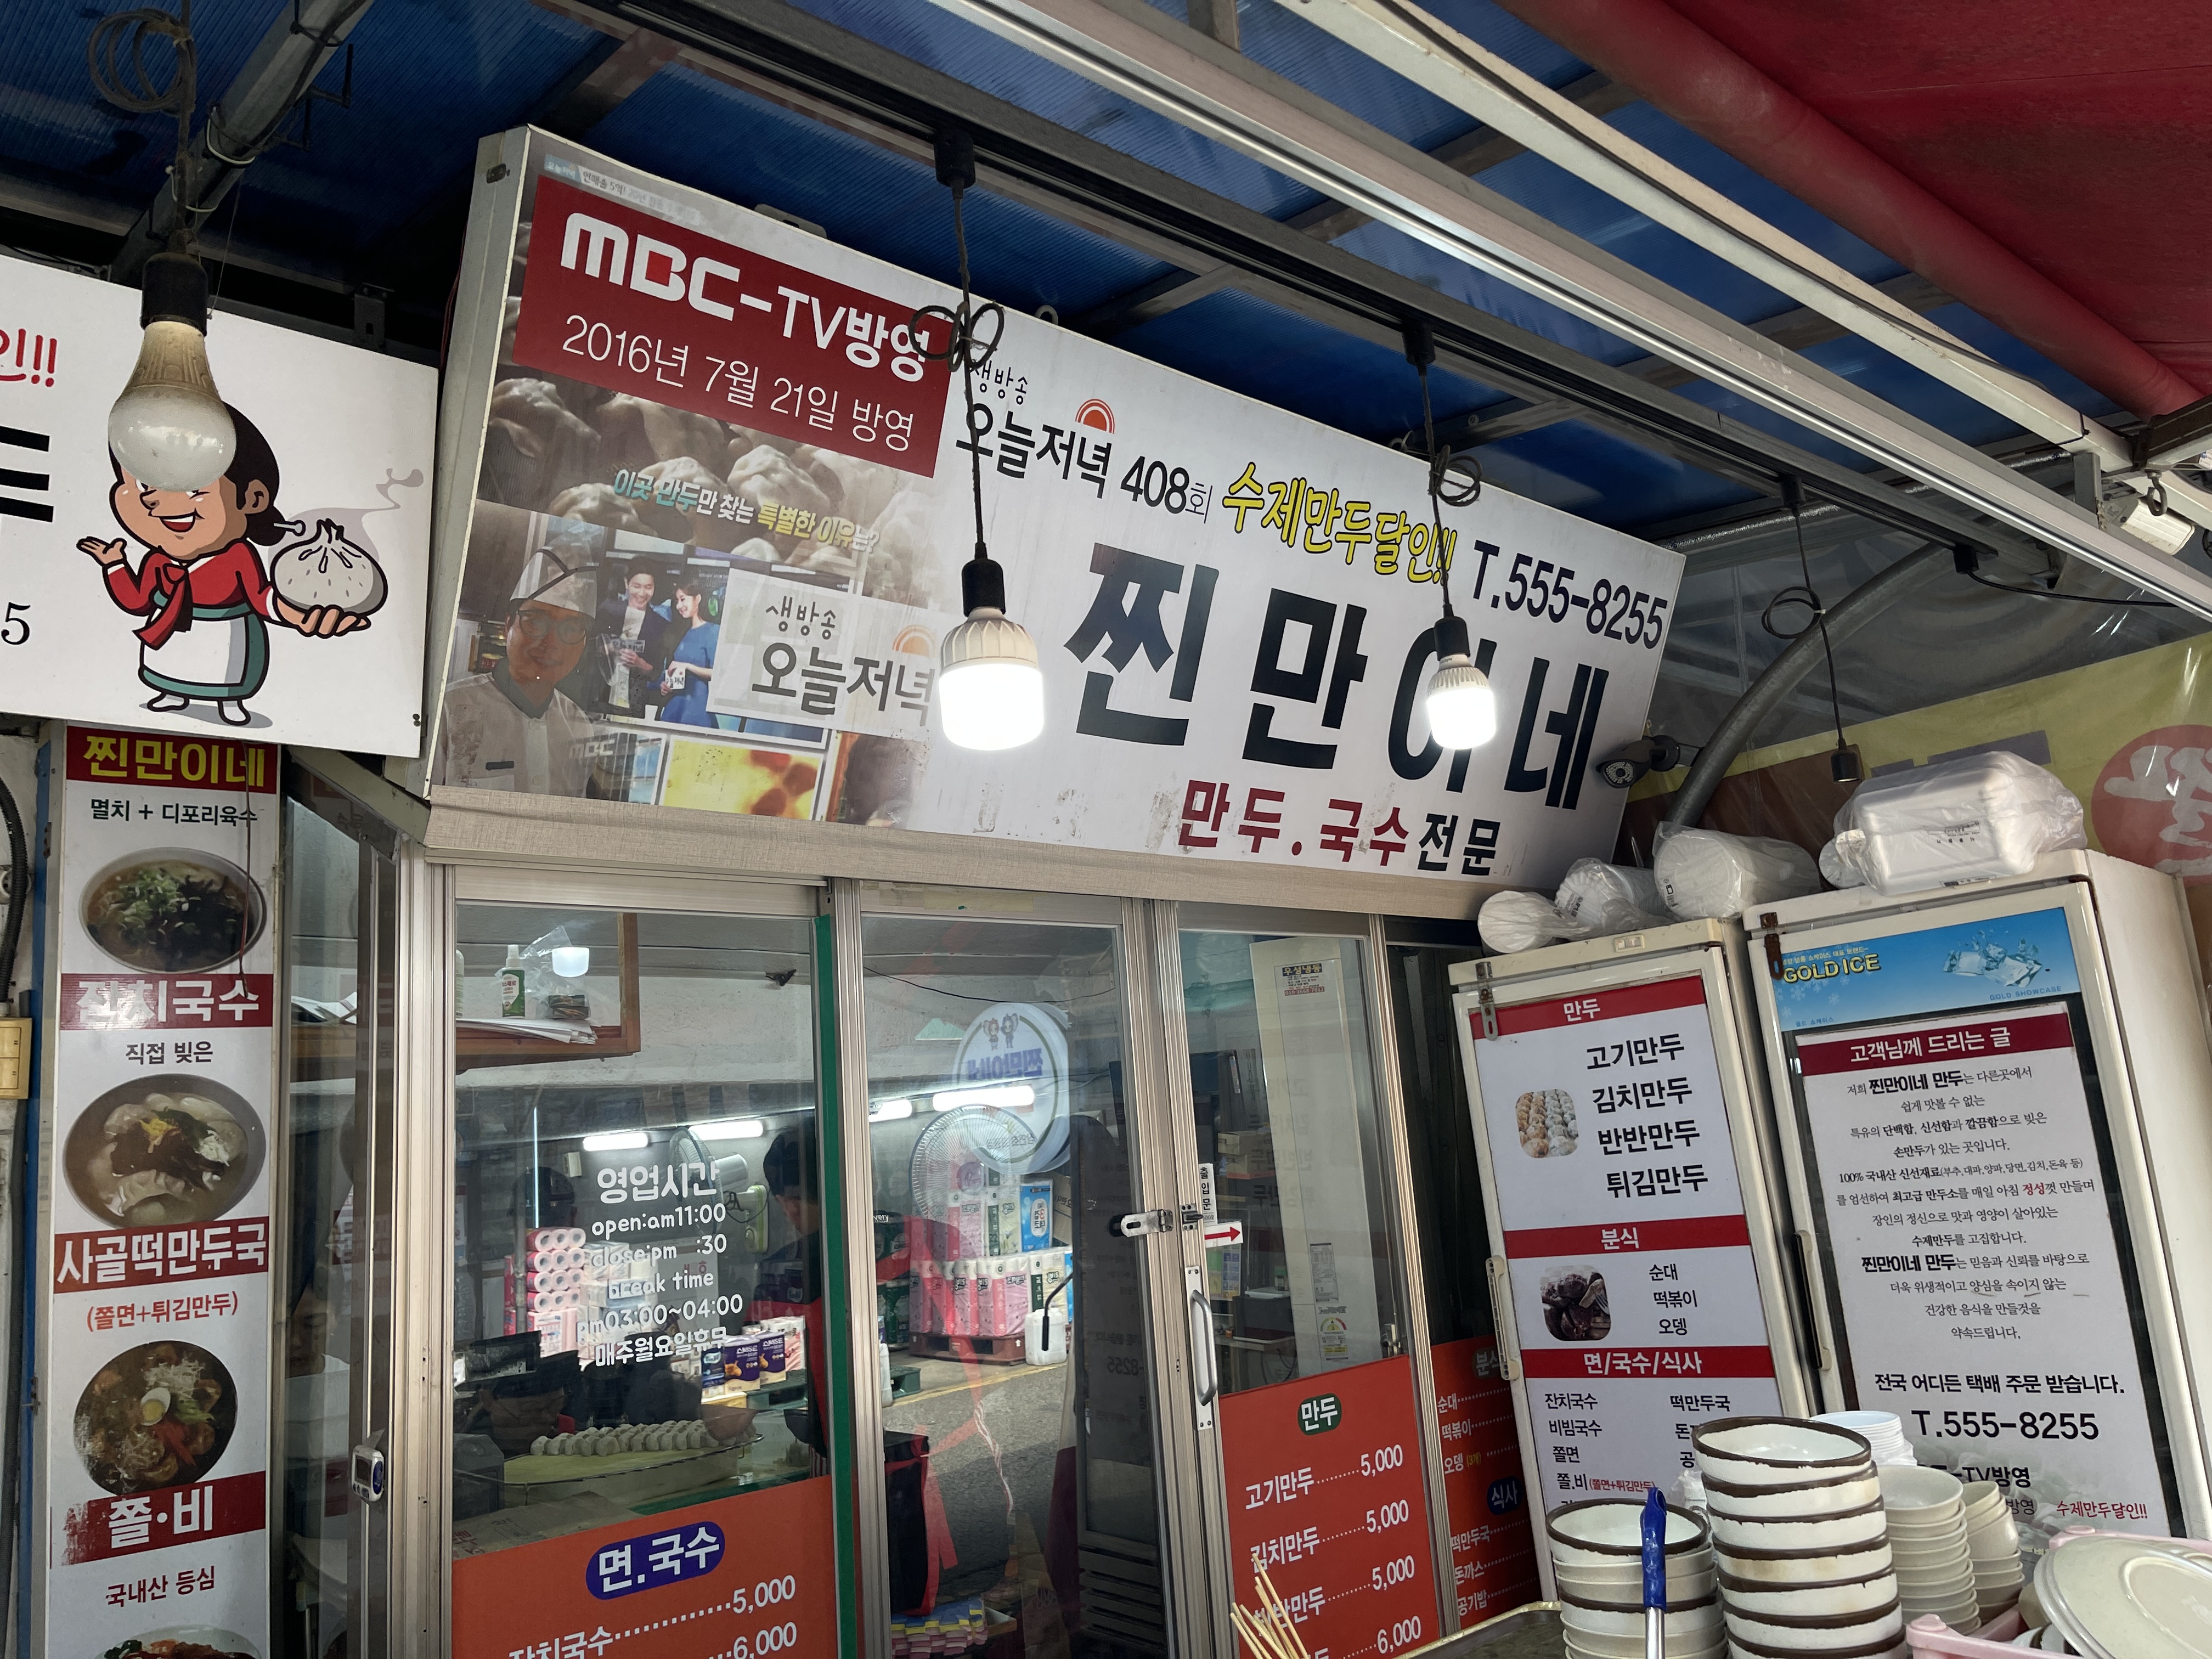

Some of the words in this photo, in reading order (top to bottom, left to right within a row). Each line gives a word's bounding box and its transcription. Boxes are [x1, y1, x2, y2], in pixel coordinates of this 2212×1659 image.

[562, 315, 689, 388] 2016년
[706, 357, 759, 409] 7월
[770, 377, 838, 432] 21일
[852, 399, 913, 453] 방영
[613, 468, 654, 500] 이곳
[655, 477, 718, 516] 만두만
[719, 494, 754, 525] 찾는
[757, 502, 816, 541] 특별한
[956, 403, 1113, 499] 오늘저녁
[1120, 456, 1212, 524] 408회
[1222, 462, 1457, 585] 수제만두달인!!
[1473, 539, 1668, 650] T.555-8255
[766, 595, 838, 641] 생방송
[752, 641, 936, 727] 오늘저녁
[83, 735, 265, 787] 찐만이네
[91, 799, 131, 821] 멸치
[162, 803, 258, 826] 디포리육수
[1783, 961, 1839, 983] GOLD
[1842, 954, 1881, 974] ICE
[1989, 992, 2012, 1001] GOLD
[2015, 985, 2062, 998] SHOWCASE
[1563, 998, 1601, 1022] 만두
[126, 1041, 166, 1065] 직접
[174, 1041, 213, 1063] 빚은
[1586, 1032, 1685, 1070] 고기만두
[1850, 1036, 1922, 1063] 고객님께
[1928, 1030, 1985, 1052] 드리는
[1989, 1026, 2011, 1048] 글
[1592, 1076, 1692, 1114] 김치만두
[1847, 1083, 1867, 1096] 저희
[1869, 1074, 1928, 1094] 찐만이네
[1932, 1070, 1974, 1088] 만두는
[1901, 1099, 1922, 1113] 쉽게
[1924, 1097, 1946, 1111] 맛볼
[1949, 1096, 1960, 1108] 수
[1962, 1094, 1985, 1107] 없는
[1598, 1119, 1700, 1155] 반반만두
[1850, 1125, 1880, 1139] 특유의
[1920, 1118, 1963, 1133] 신선함과
[1965, 1114, 2021, 1130] 깔끔함으로
[2023, 1111, 2047, 1125] 빚은
[1893, 1142, 1936, 1158] 손만두가
[1938, 1142, 1960, 1156] 있는
[1962, 1138, 2010, 1154] 곳입니다.
[597, 1162, 719, 1204] 영업시간
[1200, 1167, 1211, 1210] 출입문
[1606, 1164, 1708, 1198] 튀김만두
[1839, 1172, 1864, 1183] 100%
[1865, 1169, 1897, 1182] 국내산
[1836, 1194, 1846, 1206] 를
[1849, 1191, 1889, 1205] 엄선하여
[1892, 1190, 1923, 1203] 최고급
[1926, 1187, 1969, 1202] 만두소를
[1972, 1185, 1994, 1198] 매일
[1996, 1184, 2019, 1197] 아침
[2022, 1181, 2058, 1195] 정성껏
[2059, 1179, 2095, 1193] 만들며
[1872, 1212, 1904, 1227] 장인의
[1906, 1210, 1949, 1226] 정신으로
[1951, 1210, 1973, 1223] 맛과
[1976, 1209, 2010, 1222] 영양이
[2012, 1206, 2059, 1221] 살아있는
[1601, 1227, 1639, 1250] 분식
[1911, 1233, 1965, 1248] 수제만두를
[1968, 1231, 2027, 1245] 고집합니다.
[57, 1223, 267, 1284] 사골떡만두국
[1861, 1254, 1921, 1273] 찐만이네
[1925, 1254, 1967, 1271] 만두는
[1969, 1255, 2003, 1269] 믿음과
[2006, 1255, 2040, 1268] 신뢰를
[2042, 1254, 2090, 1267] 바탕으로
[608, 1273, 665, 1300] break
[673, 1271, 714, 1290] time
[1649, 1263, 1678, 1282] 순대
[1891, 1282, 1911, 1294] 더욱
[1914, 1280, 1968, 1294] 위생적이고
[1969, 1279, 2003, 1293] 양심을
[2006, 1278, 2040, 1291] 속이지
[2042, 1278, 2067, 1291] 않는
[87, 1291, 238, 1332] (쫄면+튀김만두)
[1653, 1289, 1698, 1308] 떡볶이
[1924, 1304, 1957, 1317] 건강한
[1959, 1302, 1993, 1316] 음식을
[1995, 1302, 2041, 1316] 만들것을
[1658, 1318, 1688, 1336] 오뎅
[1951, 1326, 2022, 1340] 약속드립니다.
[595, 1326, 727, 1367] 매주월요일휴무
[1583, 1351, 1703, 1375] 면/국수/식사
[1875, 1373, 1907, 1392] 전국
[1911, 1374, 1962, 1393] 어디든
[1966, 1374, 2001, 1394] 택배
[2005, 1375, 2042, 1394] 주문
[2046, 1374, 2125, 1395] 받습니다.
[1301, 1396, 1339, 1431] 만두
[1437, 1393, 1458, 1414] 순대
[1544, 1392, 1598, 1410] 잔치국수
[1669, 1395, 1731, 1412] 떡만두국
[1441, 1419, 1471, 1441] 떡볶이
[1548, 1419, 1602, 1437] 비빔국수
[1675, 1423, 1695, 1440] 돈
[1911, 1410, 2099, 1440] T.555-8255
[1444, 1453, 1464, 1475] 오뎅
[1553, 1446, 1580, 1464] 쫄면
[1245, 1466, 1314, 1510] 고기만두
[1360, 1443, 1403, 1477] 5,000
[1491, 1481, 1518, 1509] 식사
[2056, 1500, 2147, 1520] 수제만두달인!!
[1250, 1526, 1321, 1573] 김치만두
[1365, 1499, 1409, 1534] 5,000
[1451, 1525, 1491, 1553] 떡만두국
[598, 1526, 720, 1593] 면.국수
[1372, 1555, 1415, 1590] 5,000
[1454, 1559, 1486, 1585] 돈까스
[106, 1575, 167, 1607] 국내산
[176, 1566, 215, 1595] 등심
[732, 1574, 796, 1614] 5,000
[1458, 1590, 1488, 1616] 공기밥
[733, 1622, 797, 1659] 6,000
[1376, 1615, 1421, 1655] 6,000
